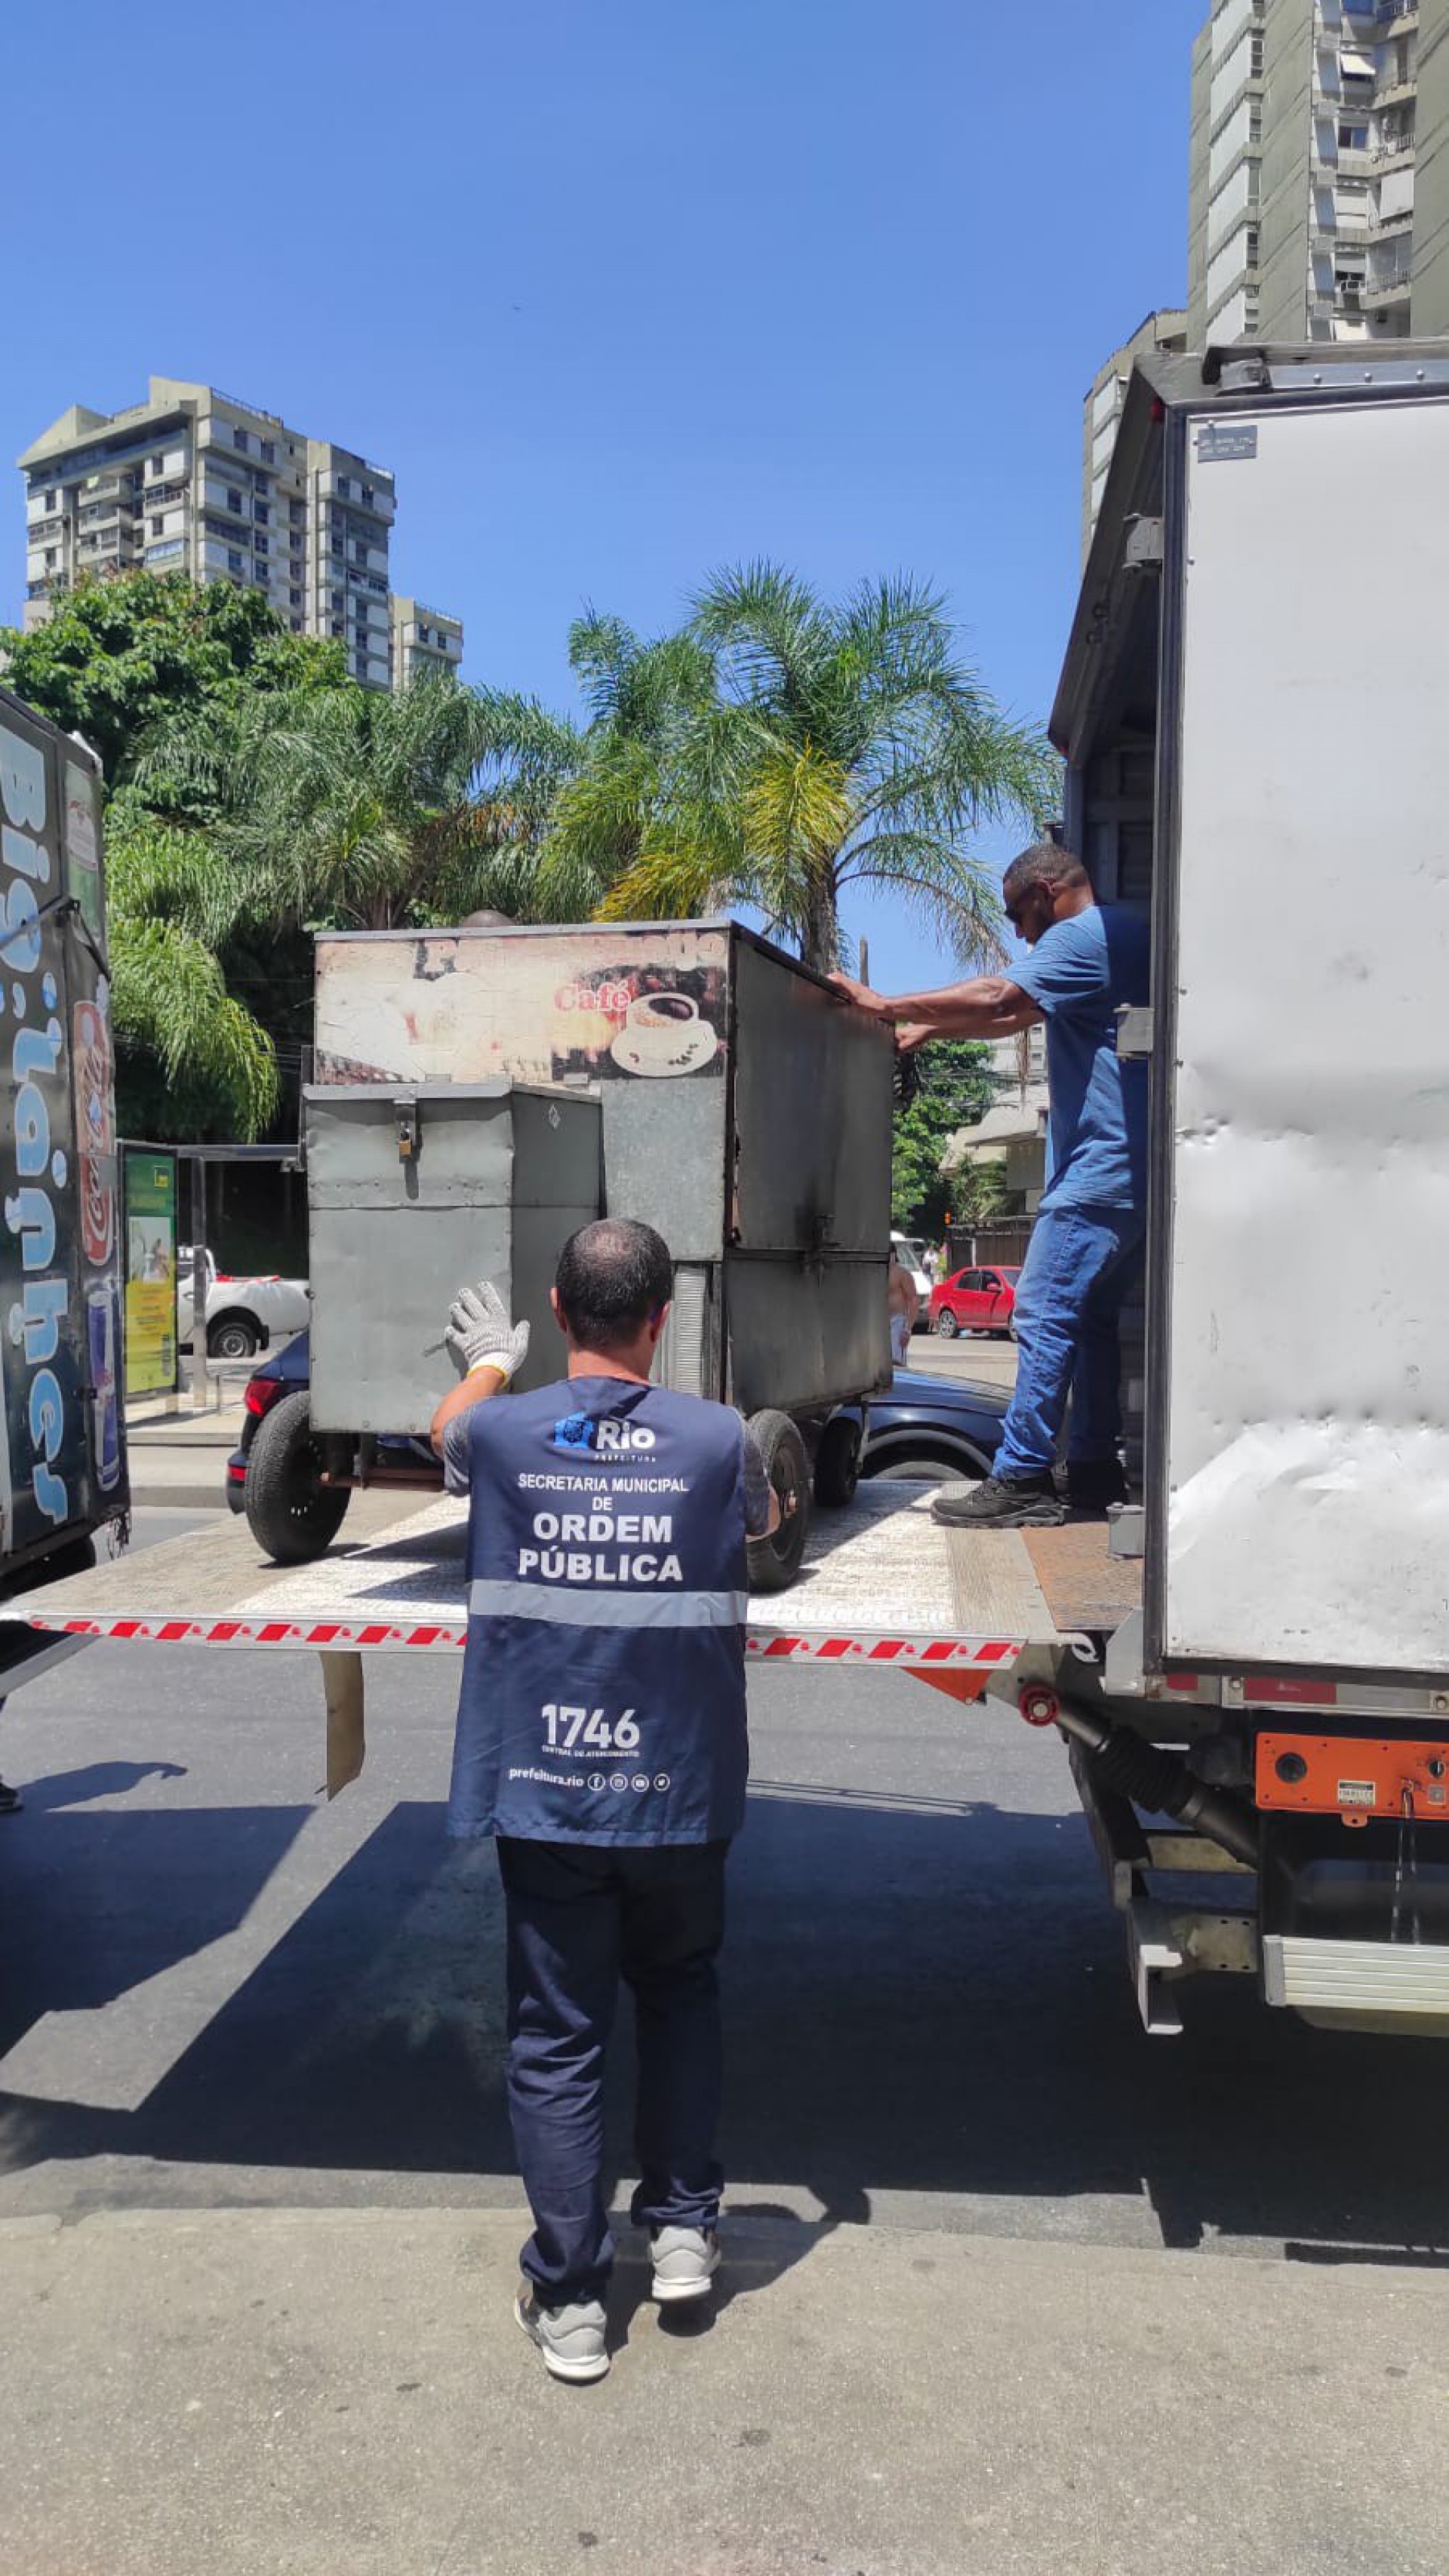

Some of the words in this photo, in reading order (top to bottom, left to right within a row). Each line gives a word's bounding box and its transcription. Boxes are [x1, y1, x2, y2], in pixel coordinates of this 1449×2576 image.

[555, 982, 631, 1011] Café
[596, 1421, 656, 1449] Rio
[518, 1472, 608, 1492] SECRETARIA
[611, 1477, 690, 1493] MUNICIPAL
[592, 1496, 613, 1511] DE
[533, 1512, 672, 1542] ORDEM
[518, 1545, 683, 1582] PÚBLICA
[541, 1704, 640, 1749] 1746
